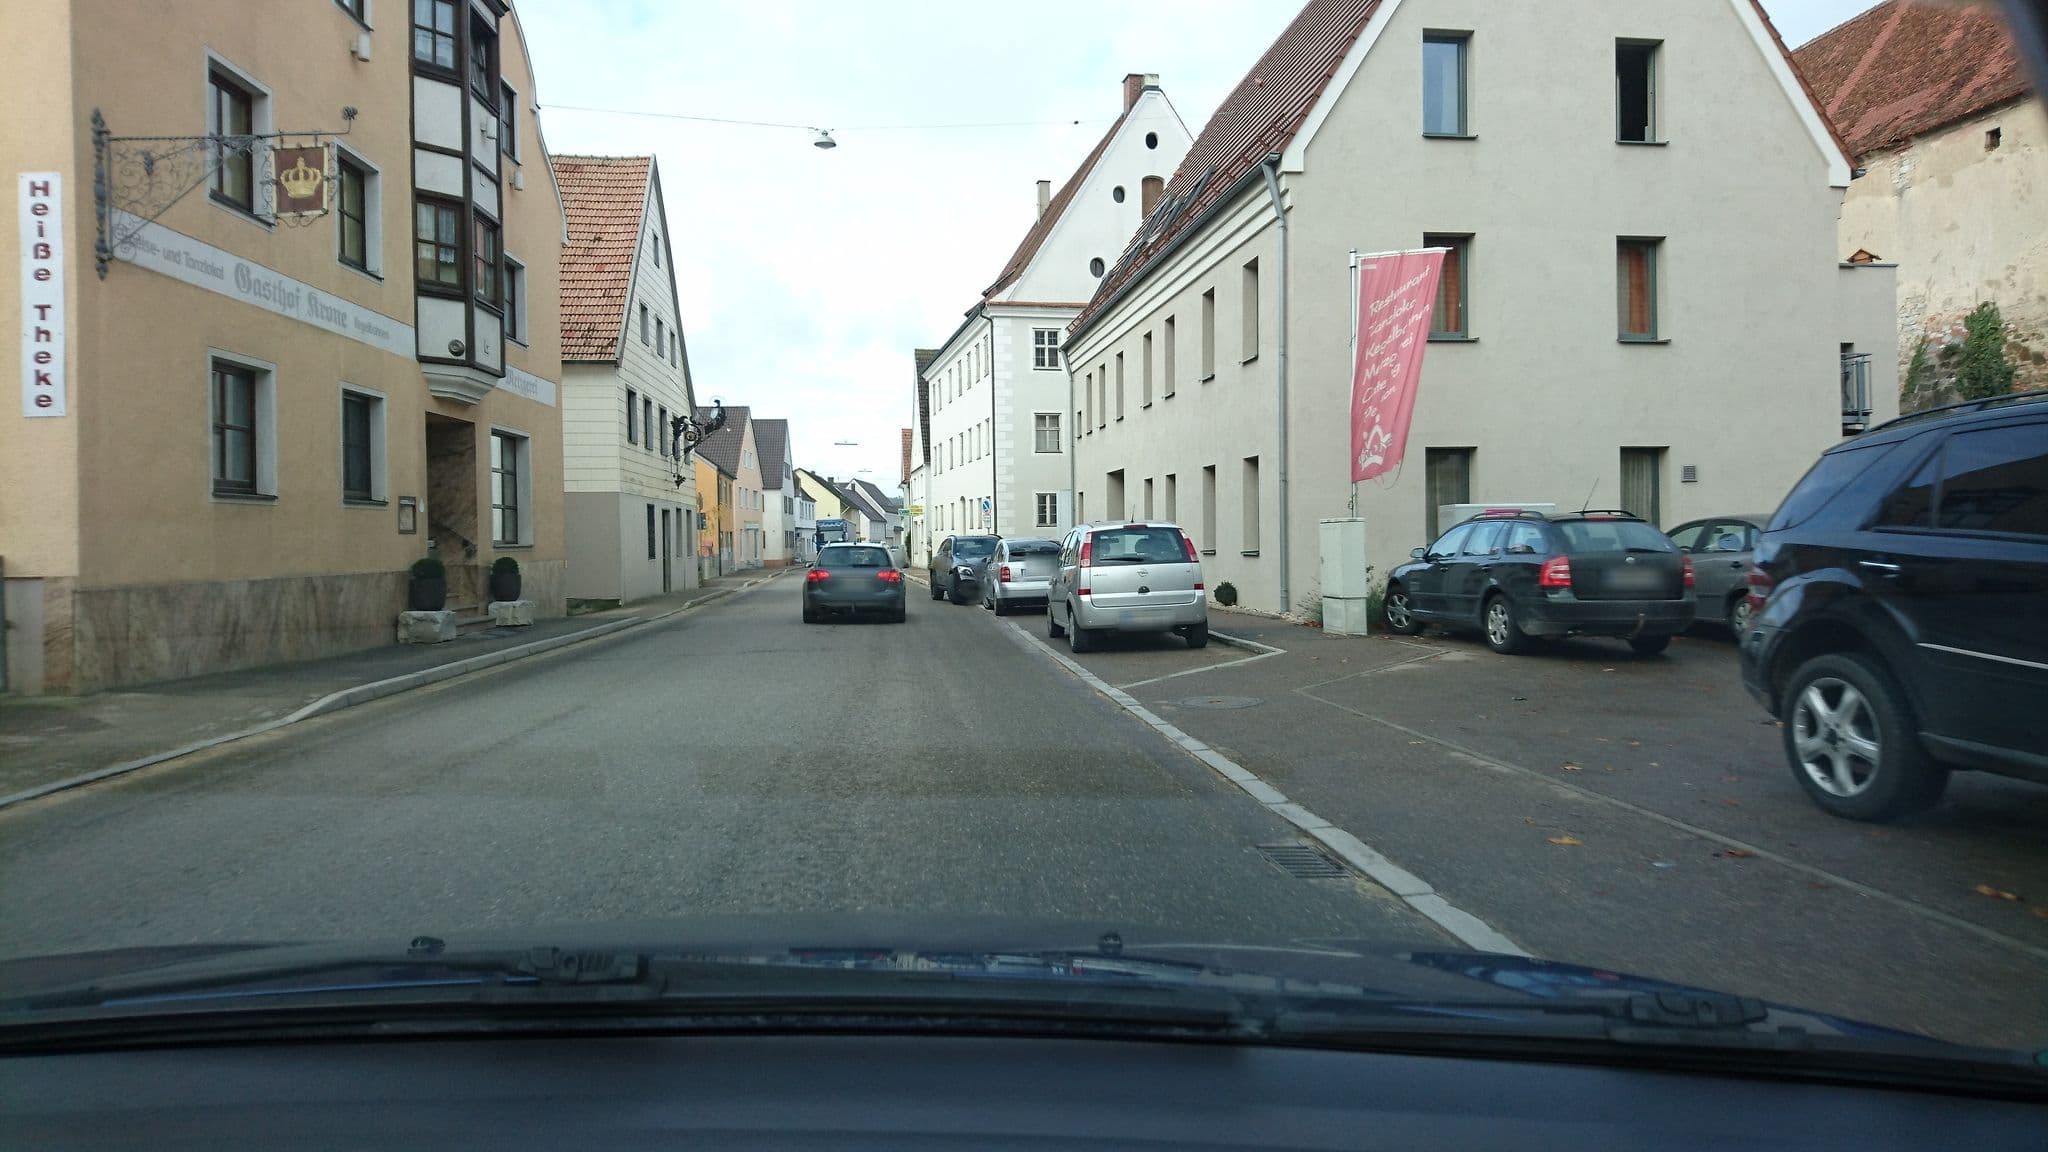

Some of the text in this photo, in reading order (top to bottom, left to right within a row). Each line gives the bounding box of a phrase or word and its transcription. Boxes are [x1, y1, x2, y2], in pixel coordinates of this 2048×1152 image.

[29, 180, 53, 408] Heiße Theke
[162, 247, 182, 266] und
[183, 250, 225, 280] Tanzlokal
[234, 262, 301, 317] Gasthof
[306, 291, 348, 329] Krone
[1369, 264, 1431, 316] Restaurant
